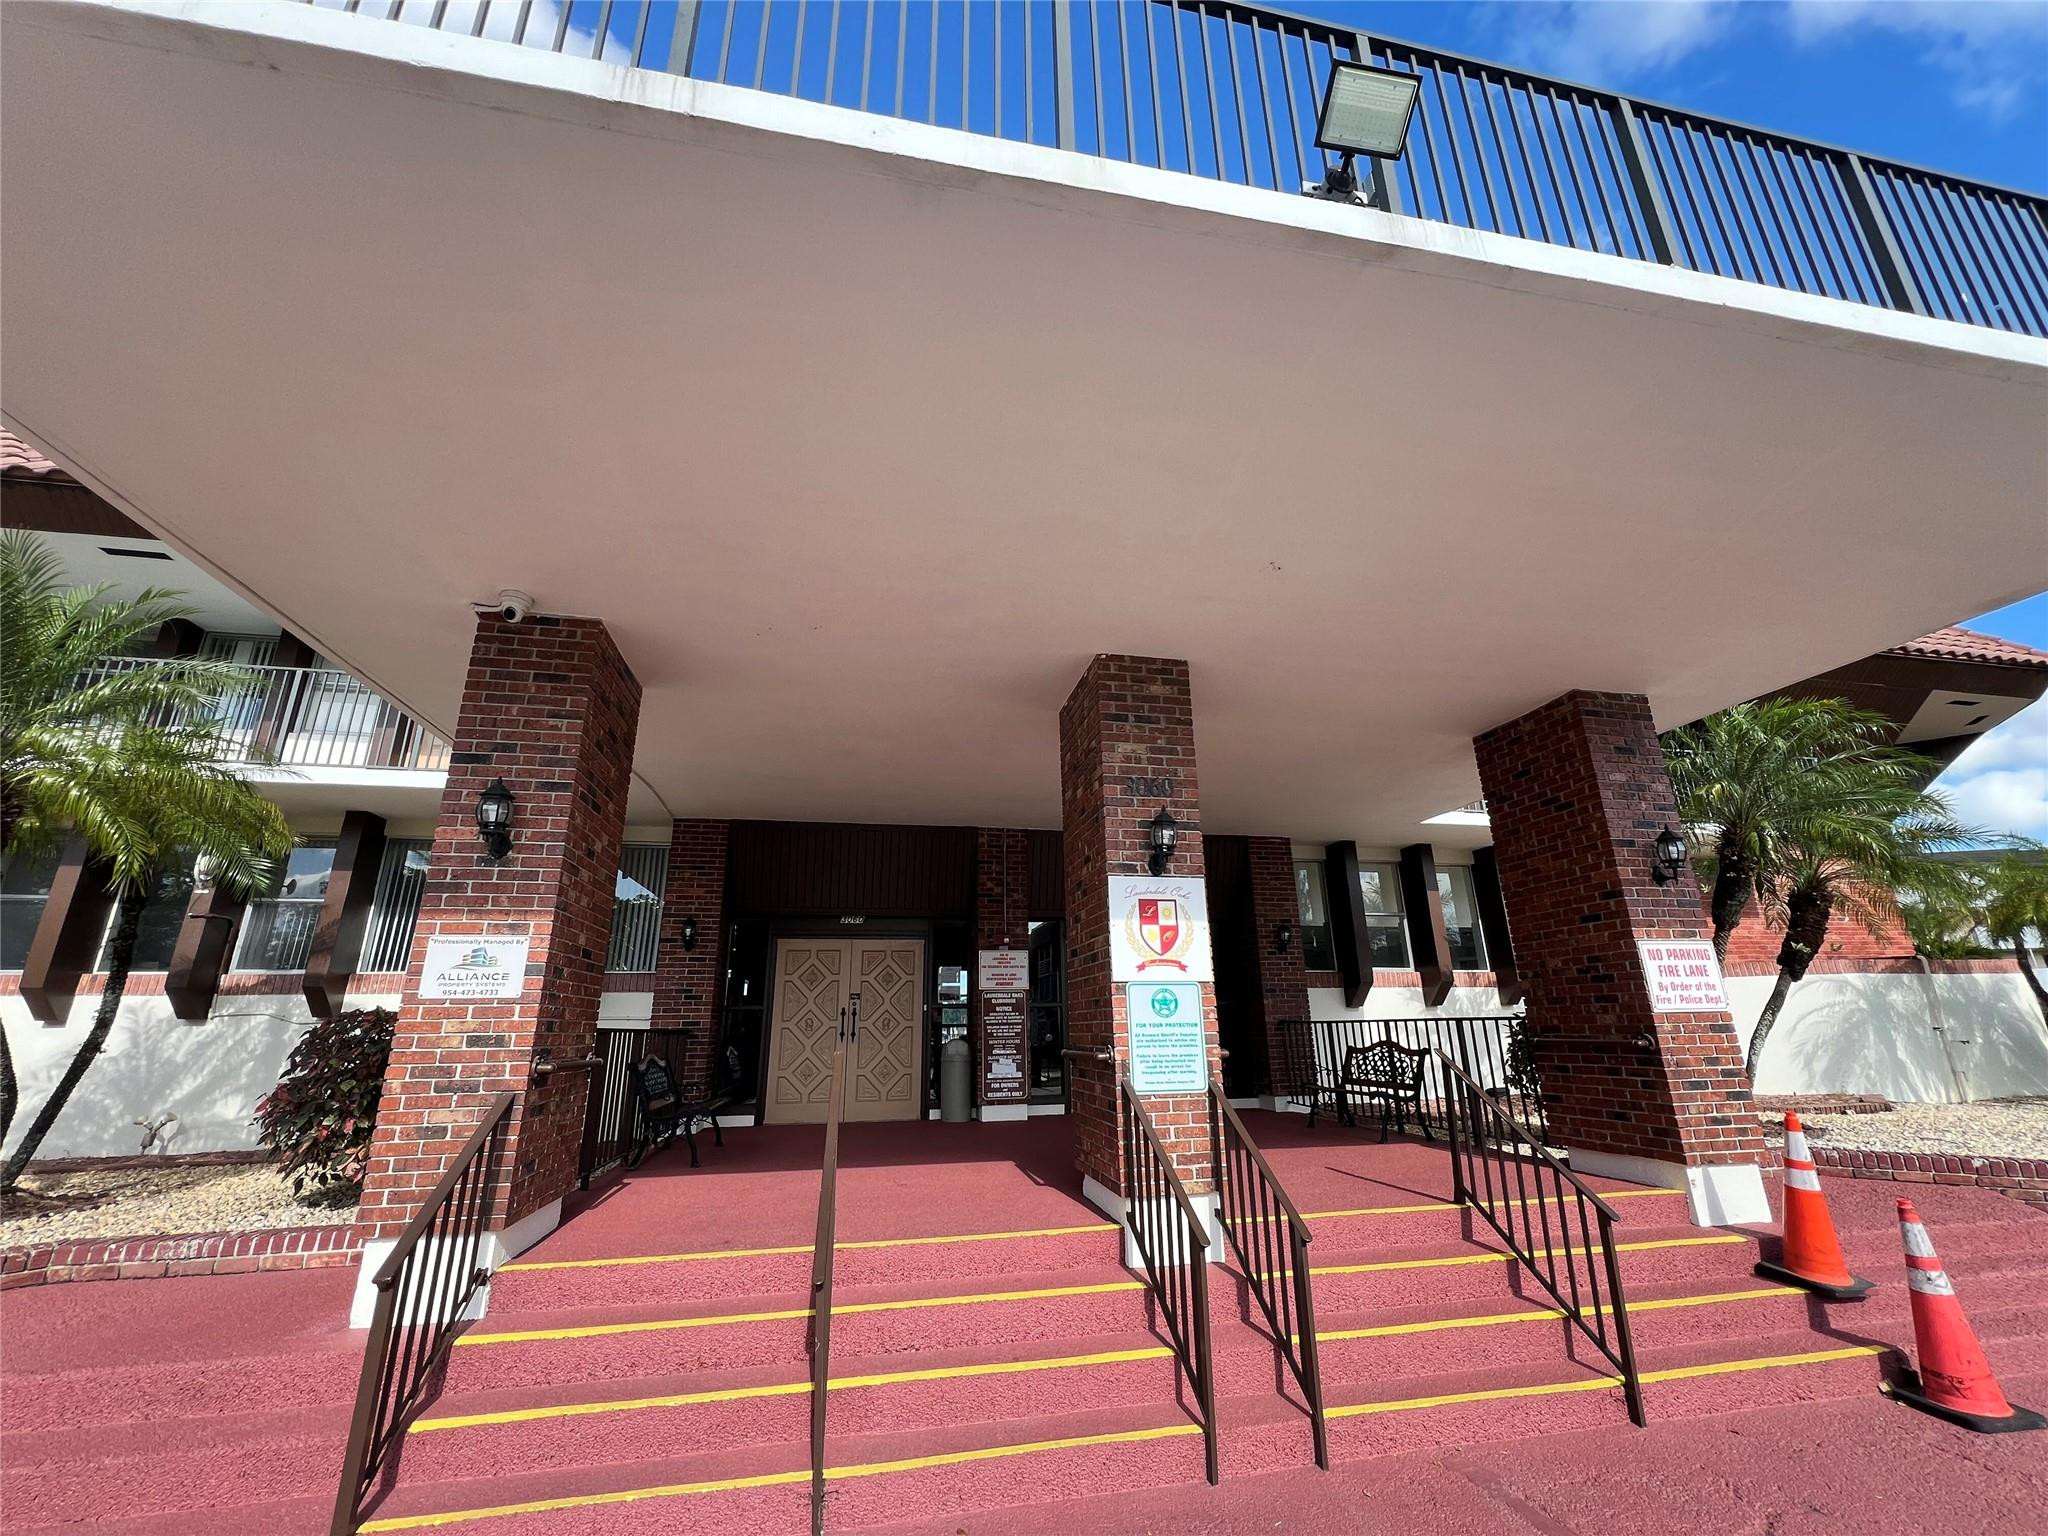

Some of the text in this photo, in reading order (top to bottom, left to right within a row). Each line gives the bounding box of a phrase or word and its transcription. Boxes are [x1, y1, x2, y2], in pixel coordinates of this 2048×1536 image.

[1646, 948, 1711, 961] NO PARKING
[436, 973, 511, 981] ALLIANCE
[1658, 965, 1710, 977] FIRE LANE
[1658, 981, 1717, 994] By Order of the
[1655, 995, 1672, 1005] Fire
[1679, 994, 1704, 1004] Police
